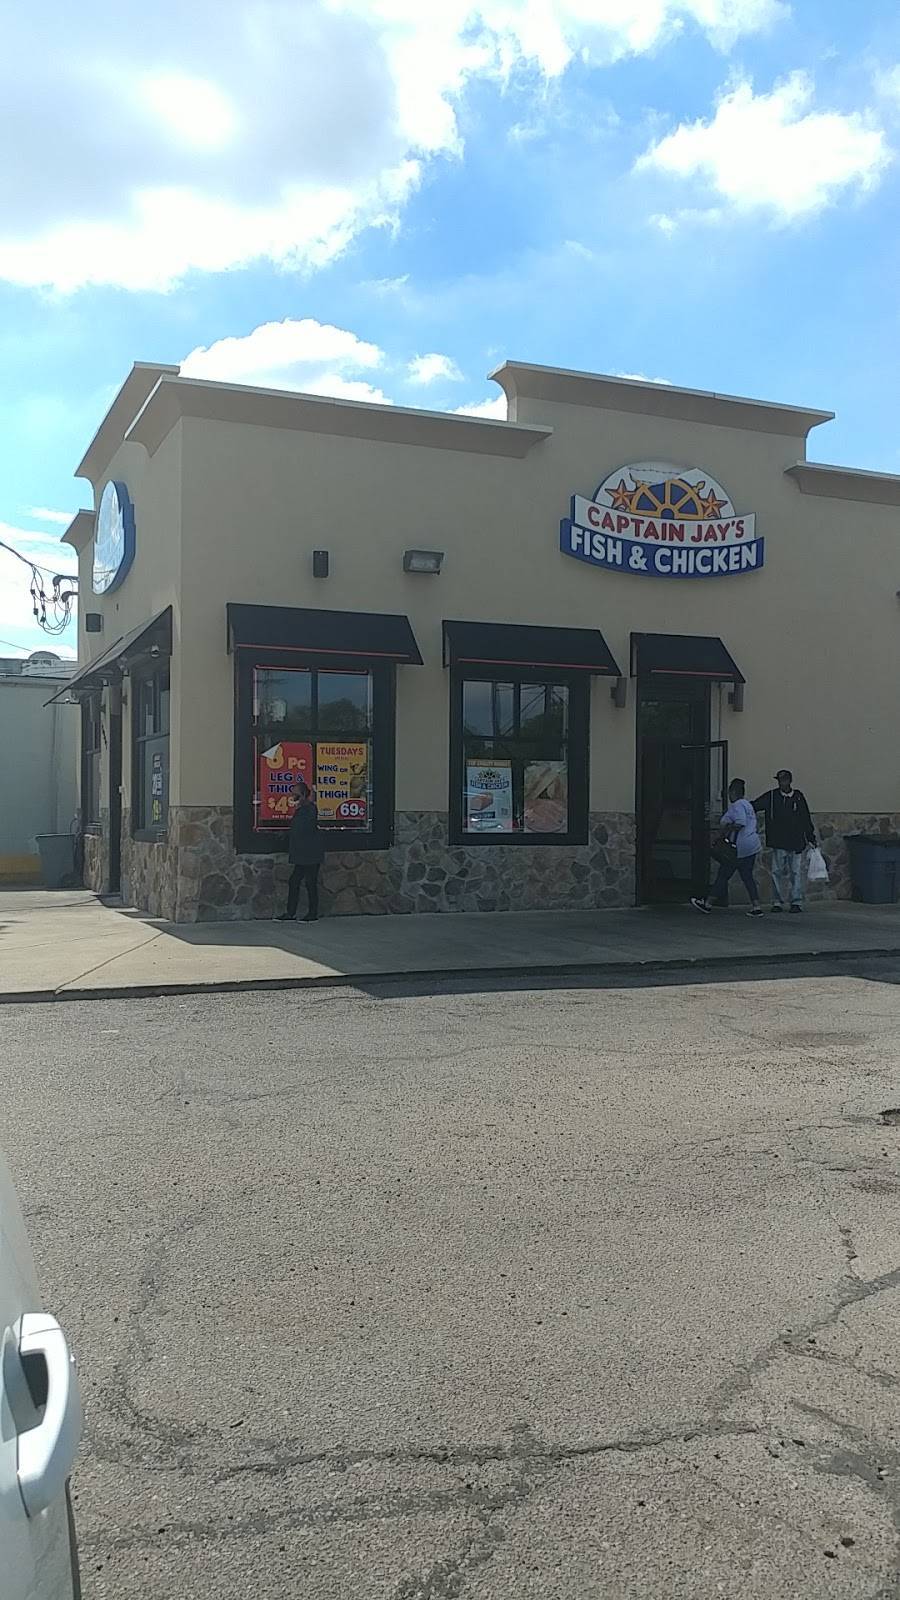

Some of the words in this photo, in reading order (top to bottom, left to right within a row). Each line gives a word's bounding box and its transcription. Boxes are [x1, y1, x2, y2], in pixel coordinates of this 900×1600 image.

[588, 506, 685, 542] CAPTAIN
[691, 520, 745, 543] JAY'S
[570, 525, 622, 565] FISH
[629, 545, 648, 571] &
[654, 542, 757, 575] CHICKEN
[319, 746, 364, 756] TUESDAYS
[287, 757, 306, 770] PC
[270, 772, 293, 782] LEG
[318, 776, 336, 784] LEG
[319, 790, 348, 799] THIGH
